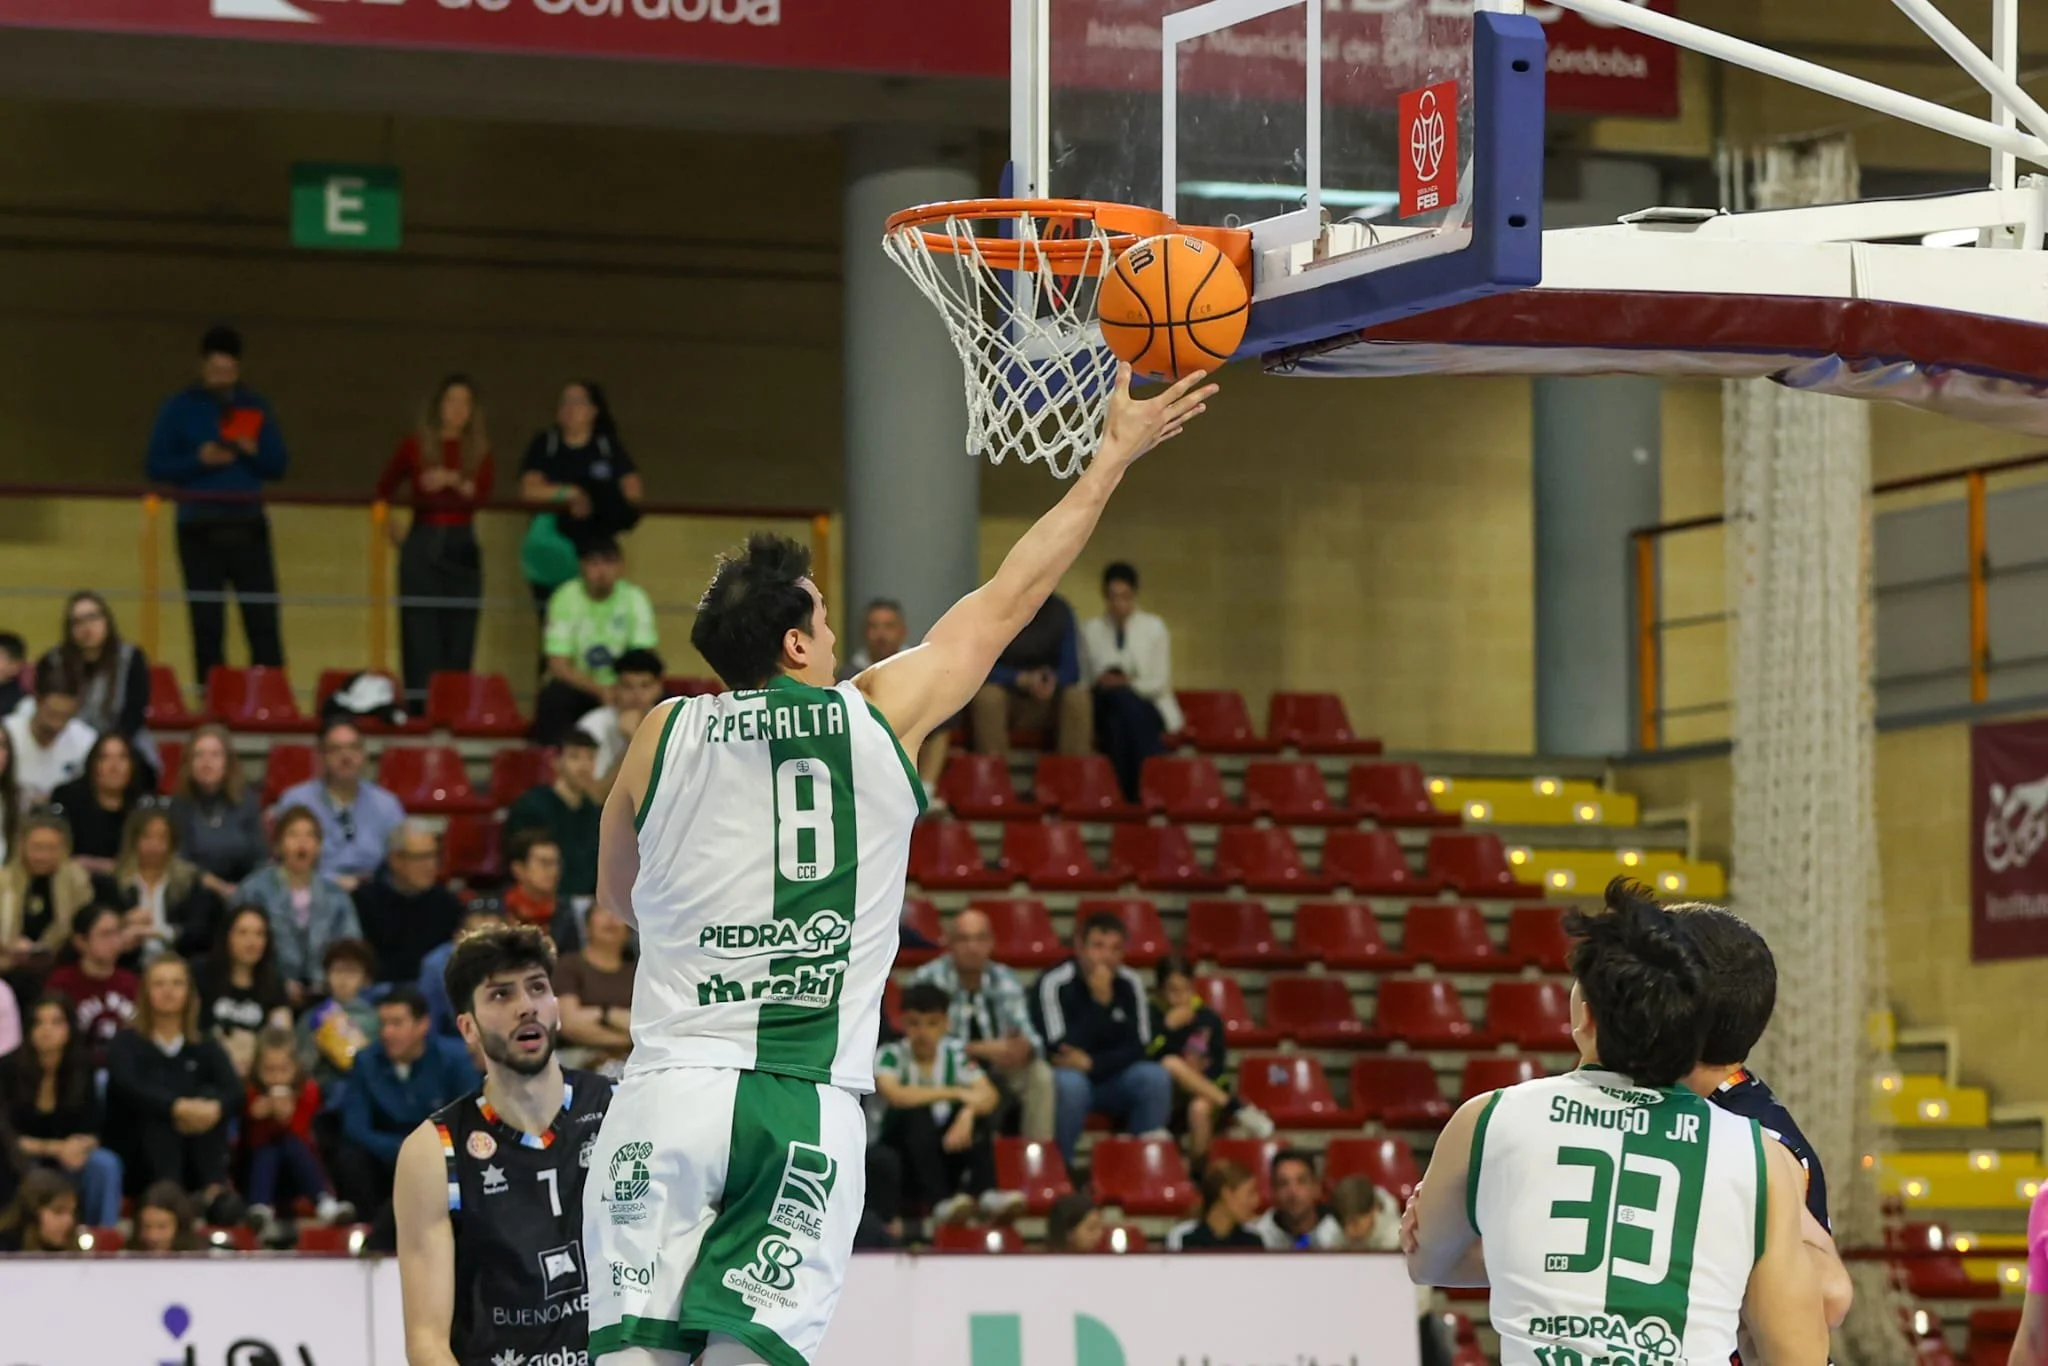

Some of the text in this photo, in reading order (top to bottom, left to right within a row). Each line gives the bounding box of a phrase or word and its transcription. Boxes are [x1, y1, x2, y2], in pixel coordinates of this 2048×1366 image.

[325, 175, 368, 235] E
[1417, 192, 1439, 211] FEB
[777, 758, 835, 882] 8
[796, 865, 817, 879] CCB
[1550, 1095, 1700, 1144] SANOGO JR
[776, 1203, 823, 1230] REALE
[1545, 1146, 1681, 1285] 33
[1547, 1256, 1569, 1270] CCB
[746, 1294, 774, 1309] HOTELS
